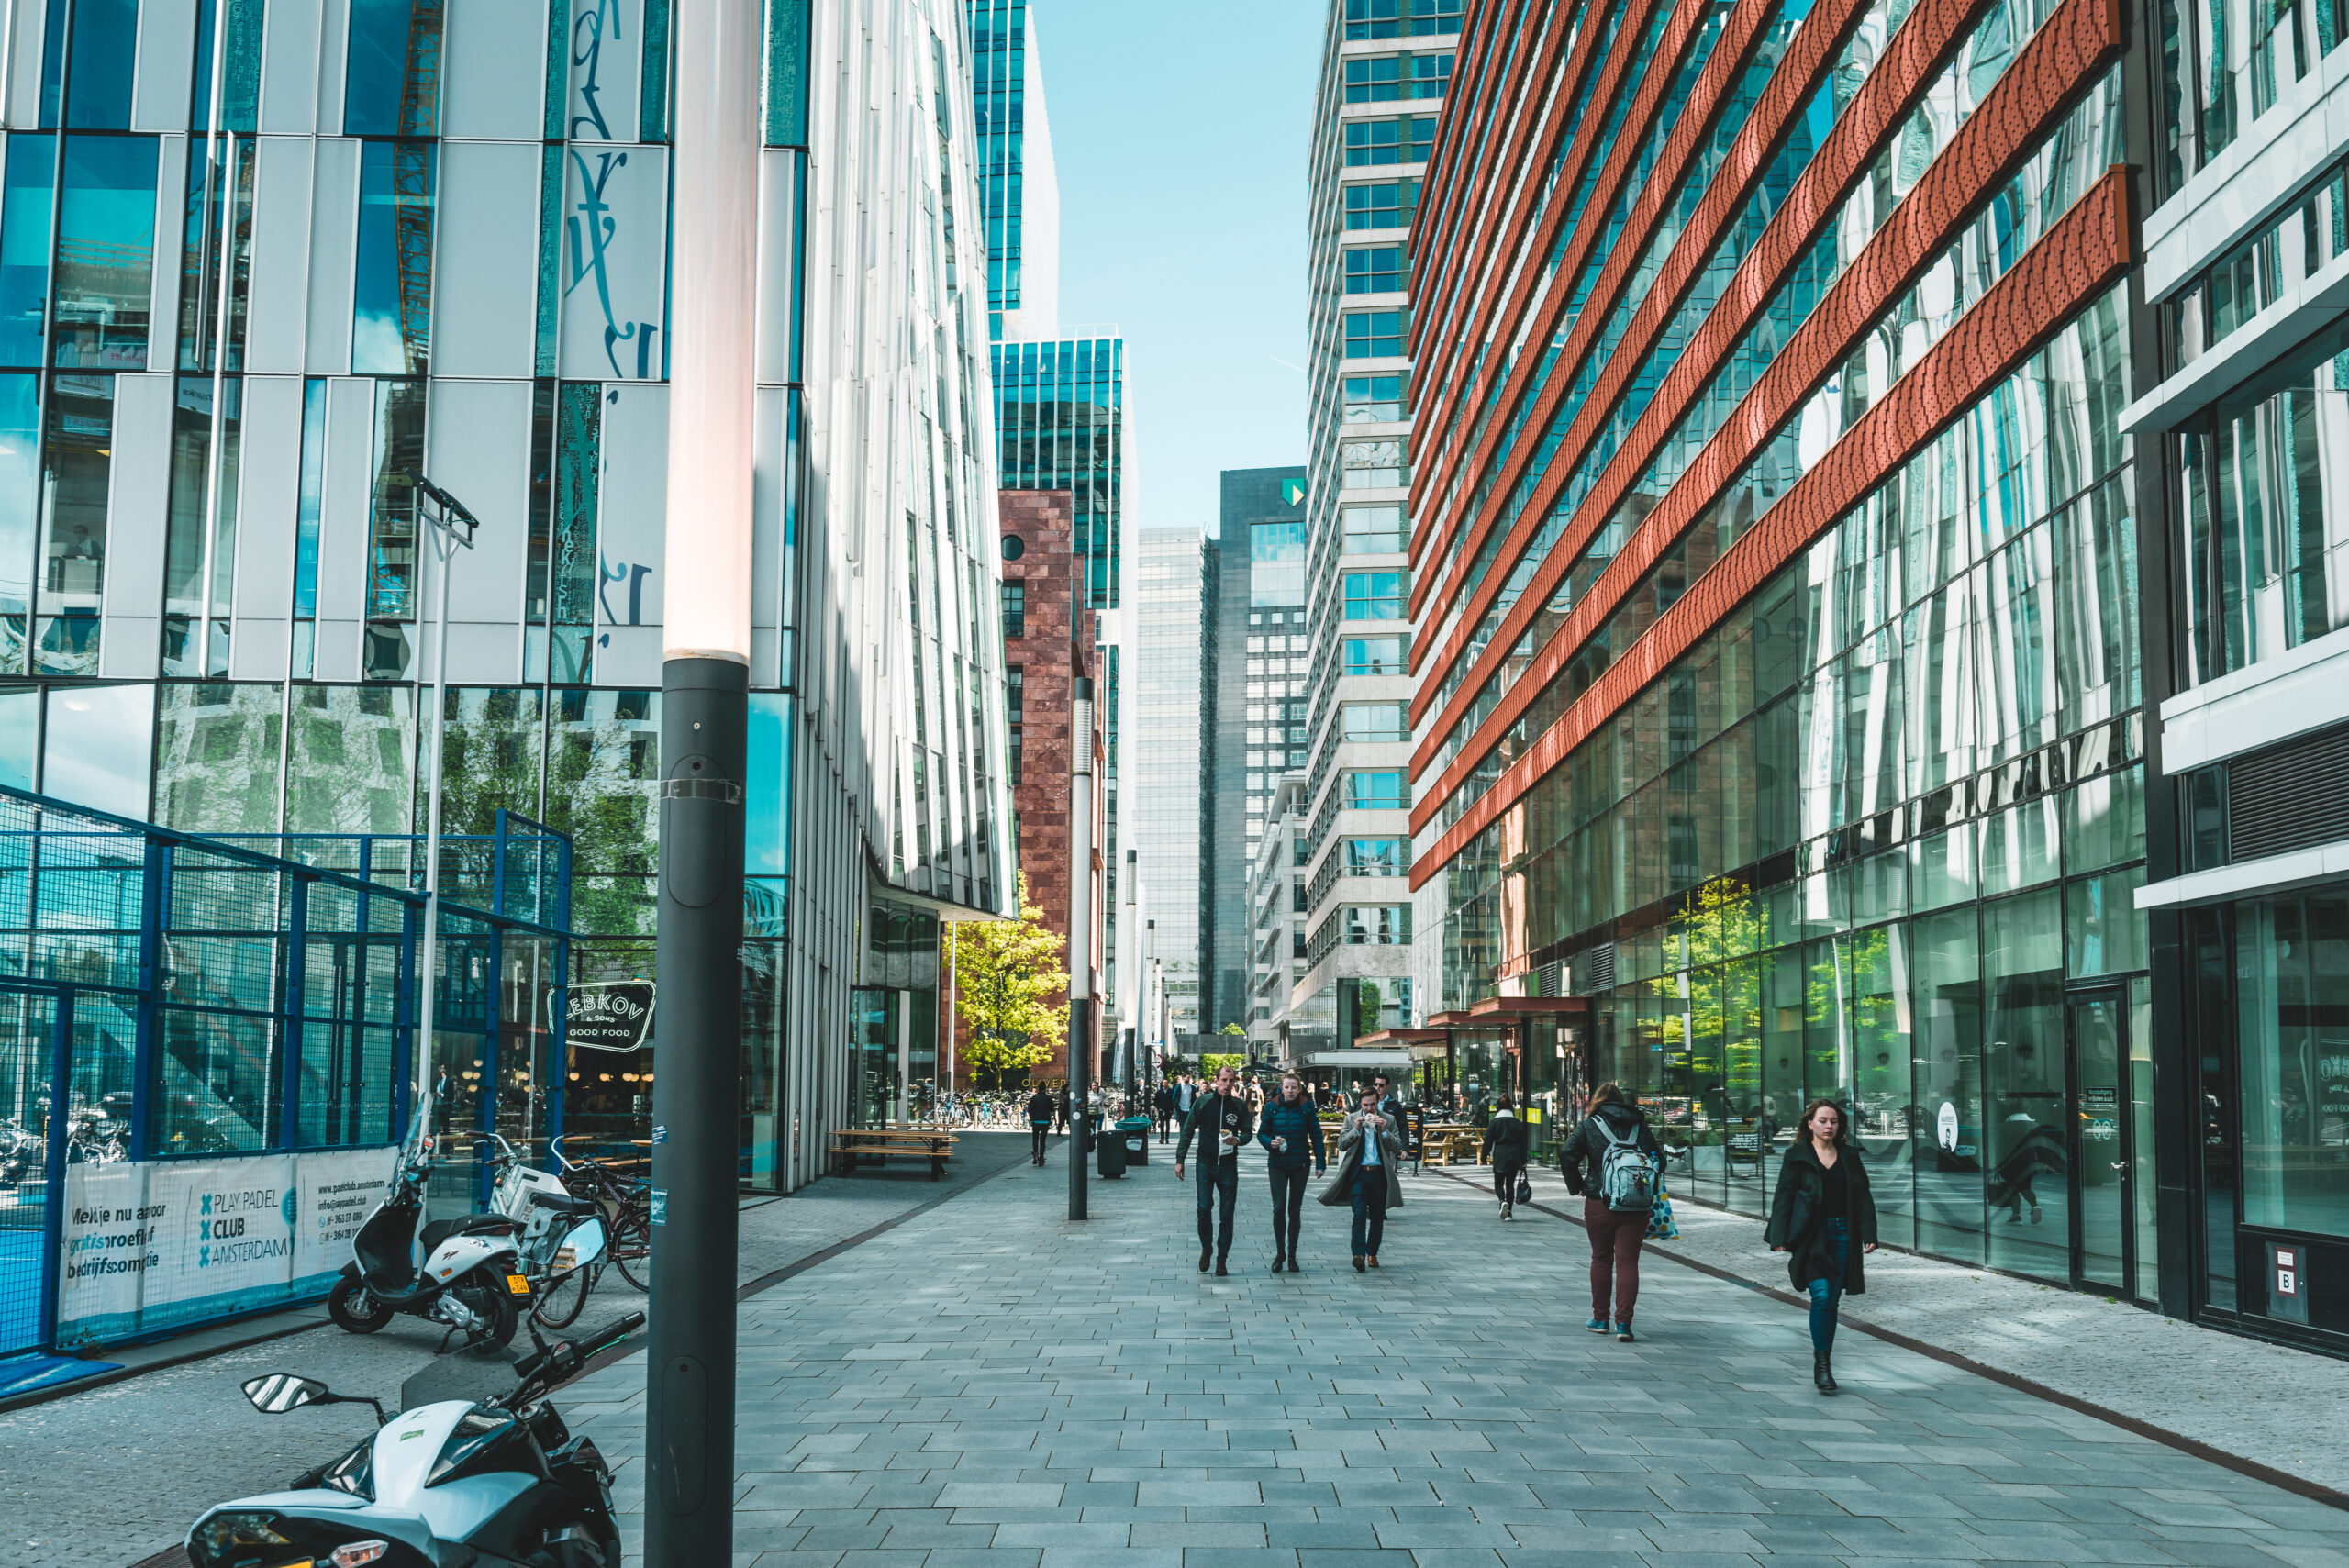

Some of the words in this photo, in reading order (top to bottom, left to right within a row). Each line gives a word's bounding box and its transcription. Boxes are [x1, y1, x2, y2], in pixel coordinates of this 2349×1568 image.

[594, 1014, 616, 1023] SONS
[214, 1192, 240, 1214] PLAY
[242, 1189, 279, 1211] PADEL
[115, 1208, 132, 1222] nu
[213, 1218, 245, 1240] CLUB
[211, 1237, 289, 1267] AMSTERDAM
[2283, 1273, 2290, 1289] B
